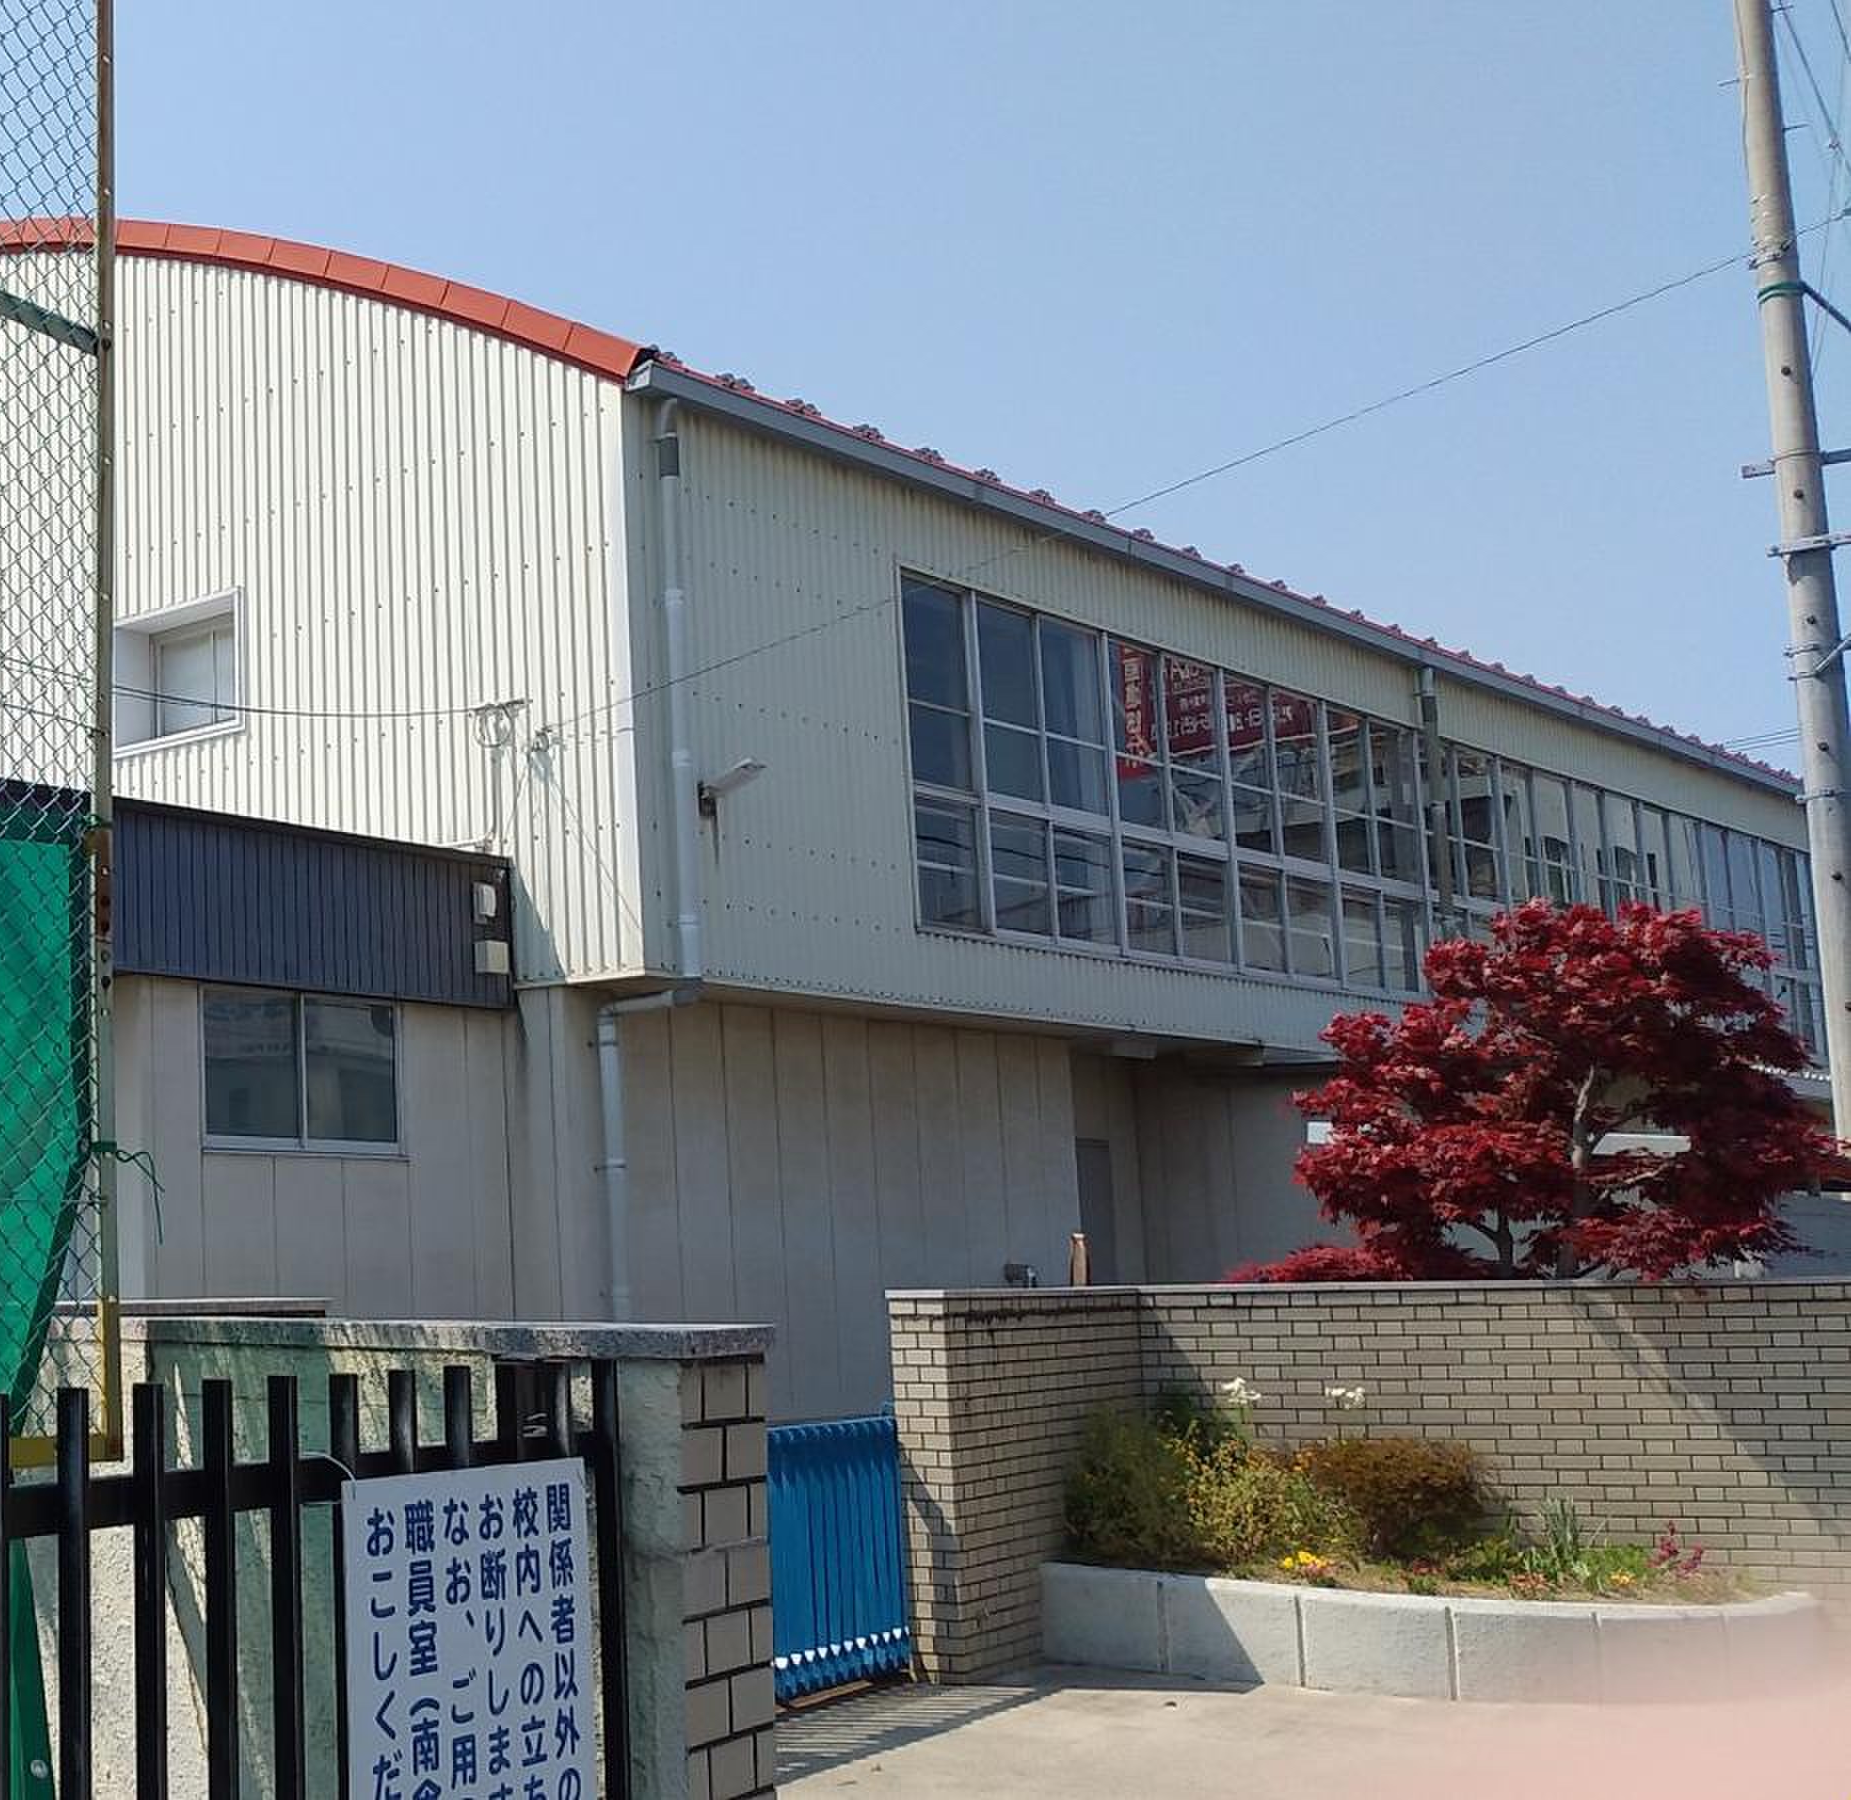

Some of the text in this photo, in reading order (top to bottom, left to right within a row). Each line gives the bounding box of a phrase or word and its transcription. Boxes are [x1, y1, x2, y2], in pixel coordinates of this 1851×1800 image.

[443, 1498, 477, 1800] なお、ご用
[546, 1483, 583, 1800] 関係者以外の
